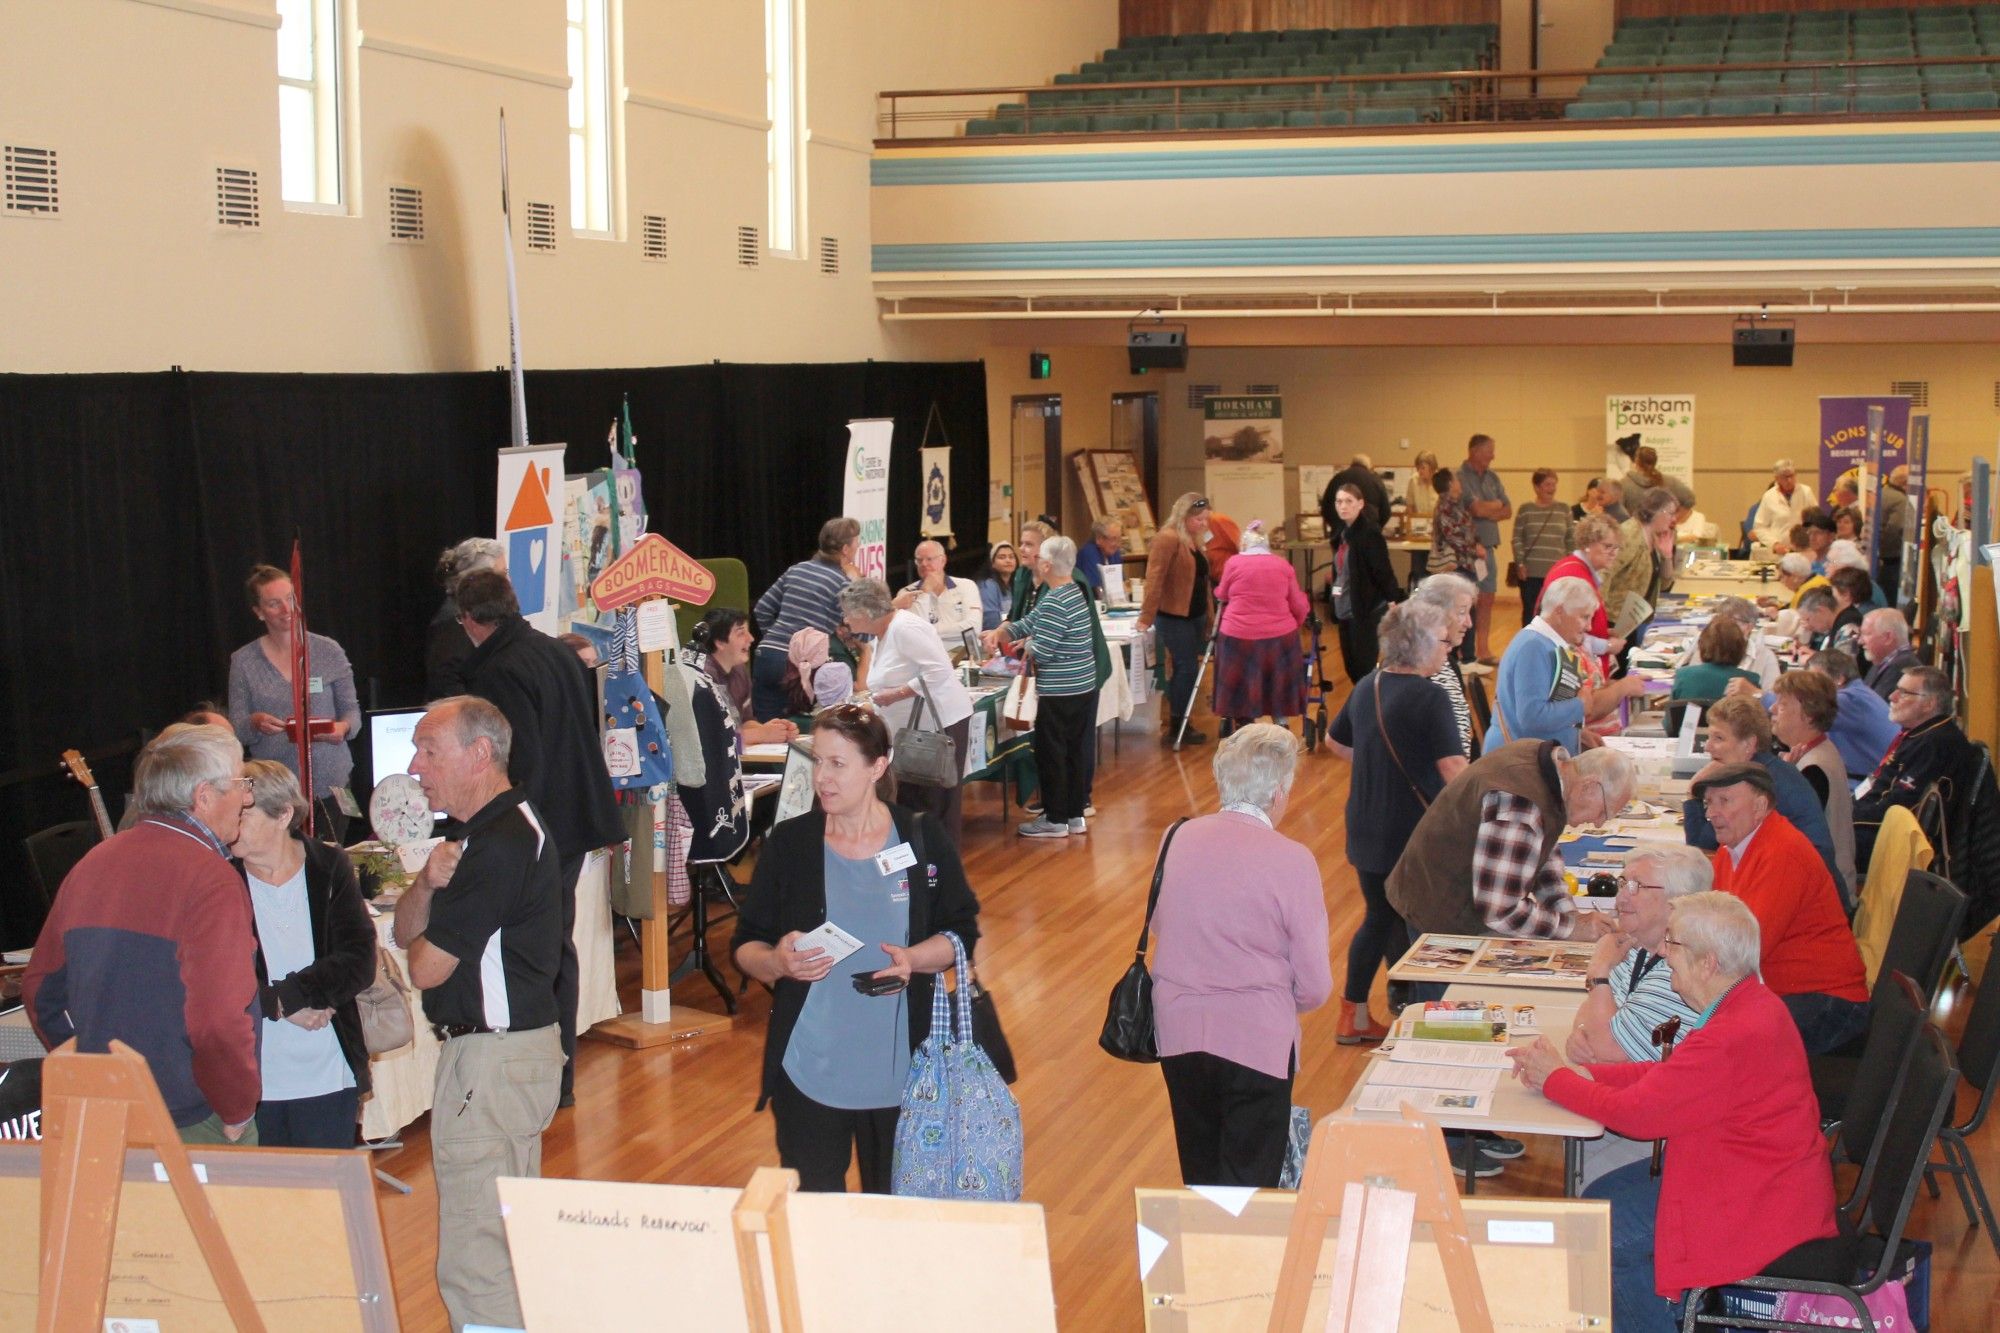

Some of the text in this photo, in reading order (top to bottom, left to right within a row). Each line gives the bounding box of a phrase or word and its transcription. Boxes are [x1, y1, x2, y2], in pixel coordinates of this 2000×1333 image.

[1214, 400, 1272, 410] HORSHAM
[1616, 412, 1665, 430] paws
[1823, 426, 1867, 449] LIONS
[605, 545, 703, 592] BOOMERANG
[639, 580, 671, 592] BAGS
[557, 1209, 630, 1228] Rocklands
